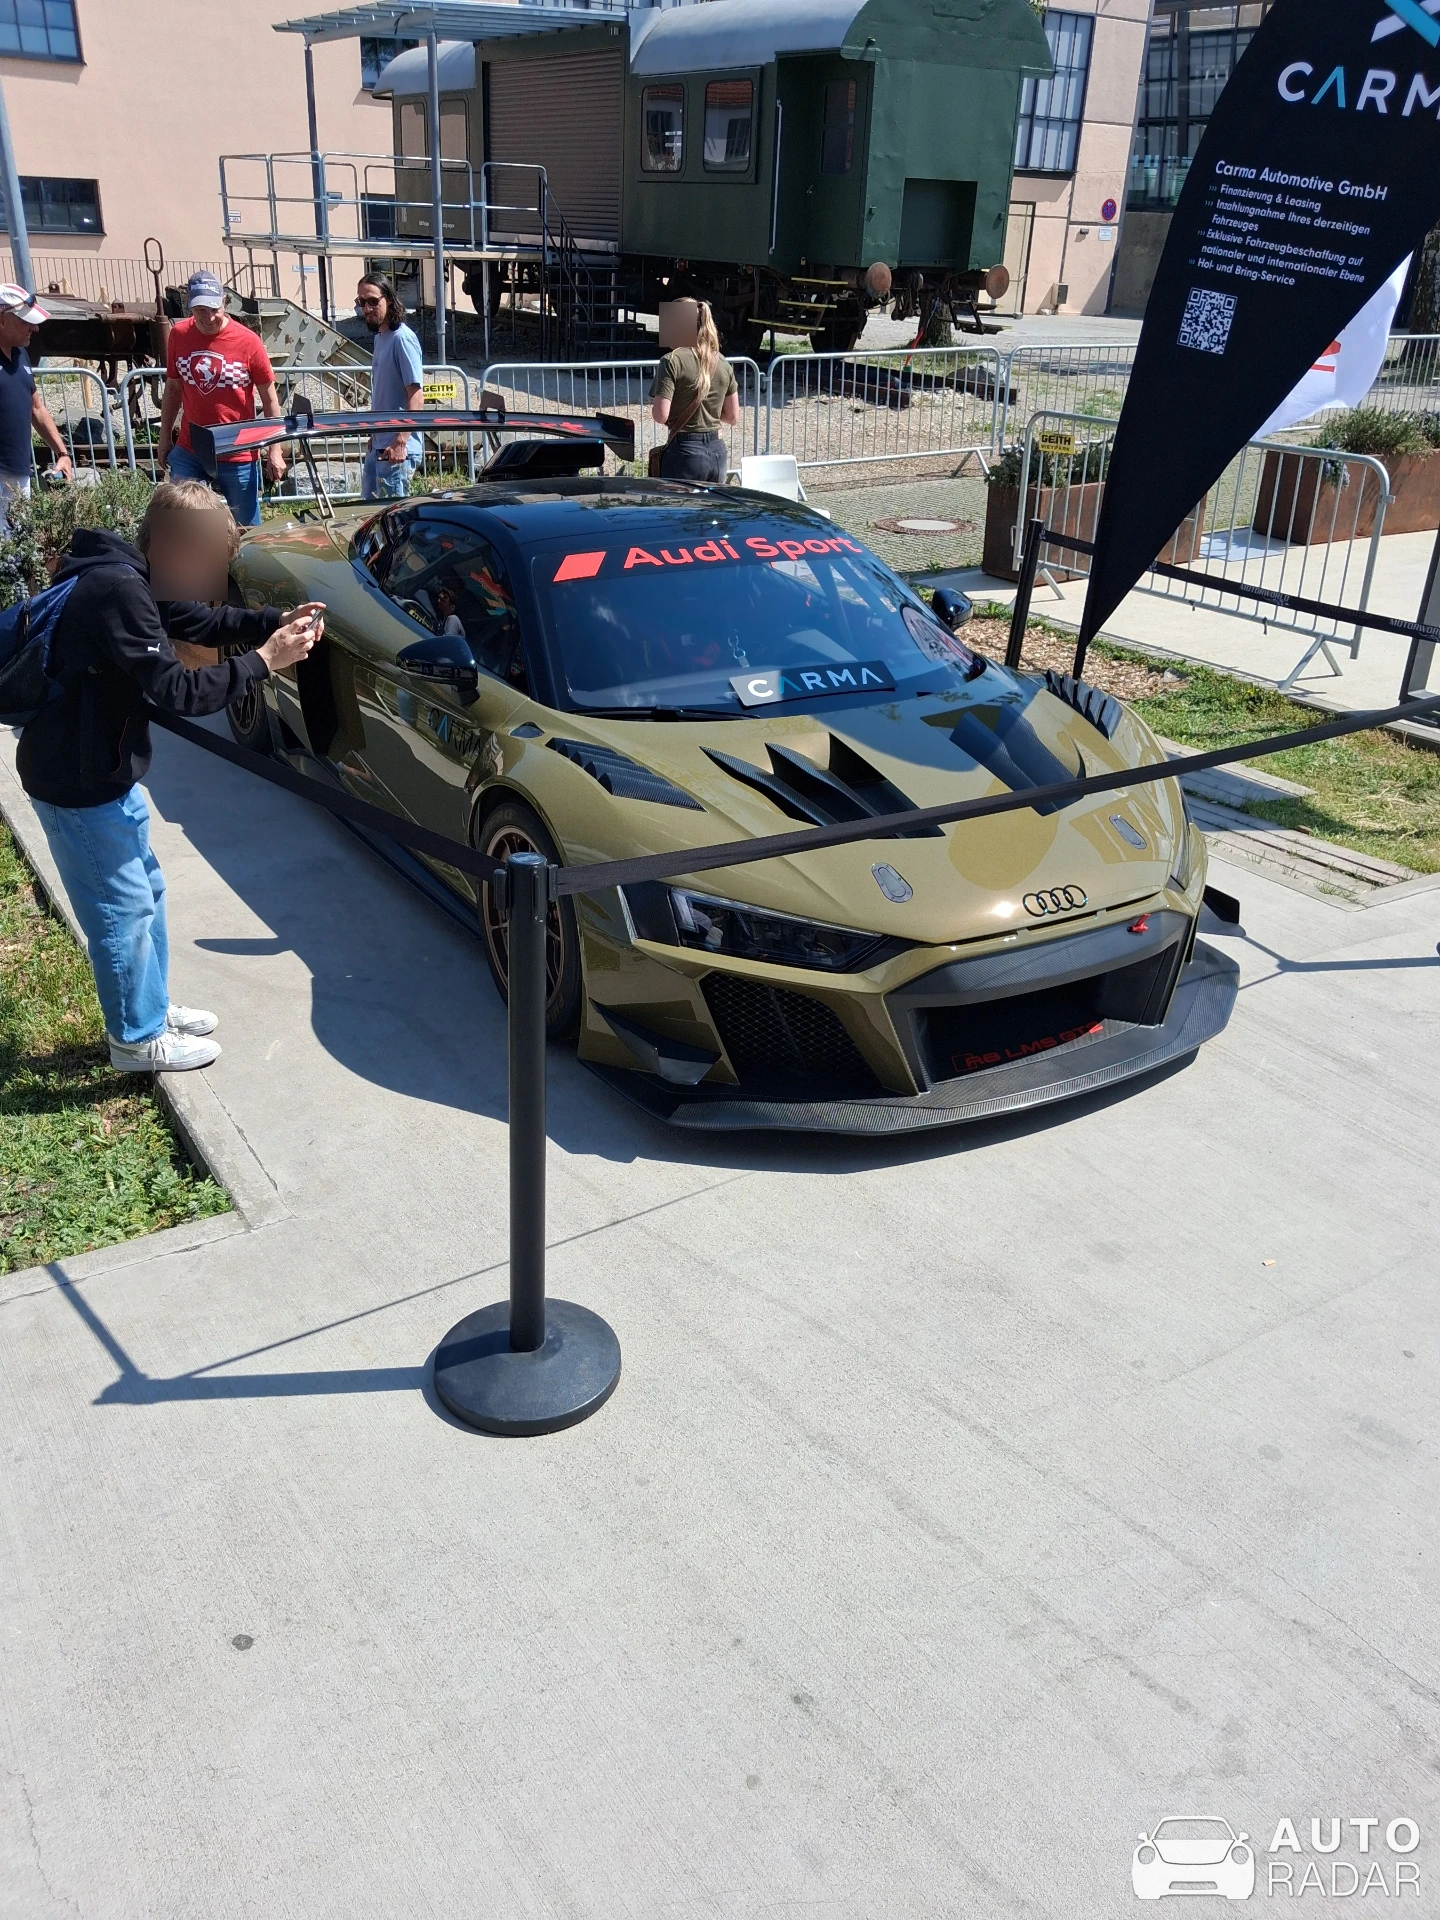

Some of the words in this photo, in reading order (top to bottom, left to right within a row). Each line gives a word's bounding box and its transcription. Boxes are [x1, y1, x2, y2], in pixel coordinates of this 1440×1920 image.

[1278, 61, 1440, 120] CARM
[1215, 160, 1257, 179] Carma
[1259, 167, 1334, 192] Automotive
[1338, 180, 1388, 200] GmbH
[1220, 184, 1273, 204] Finanzierung
[1275, 194, 1283, 203] &
[1284, 195, 1322, 212] Leasing
[1211, 214, 1259, 232] Fahrzeuges
[1216, 199, 1286, 221] Inzahlungnahme
[1287, 211, 1311, 225] Ihres
[1313, 217, 1371, 236] derzeitigen
[1206, 228, 1244, 244] Exklusive
[1245, 235, 1346, 265] Fahrzeugbeschaffung
[1347, 256, 1364, 267] auf
[1197, 257, 1214, 269] Hol-
[1215, 262, 1234, 273] und
[1234, 265, 1296, 286] Bring-Service
[1201, 244, 1246, 261] nationaler
[1247, 254, 1266, 265] und
[1266, 255, 1338, 278] internationaler
[1338, 269, 1365, 284] Ebene
[422, 384, 454, 393] GEITH
[1041, 434, 1071, 445] GEITH
[623, 539, 740, 569] Audi
[745, 536, 863, 561] Sport
[1240, 583, 1290, 602] MOTORWORLD
[747, 667, 884, 698] CARMA
[1005, 1036, 1057, 1058] LMS
